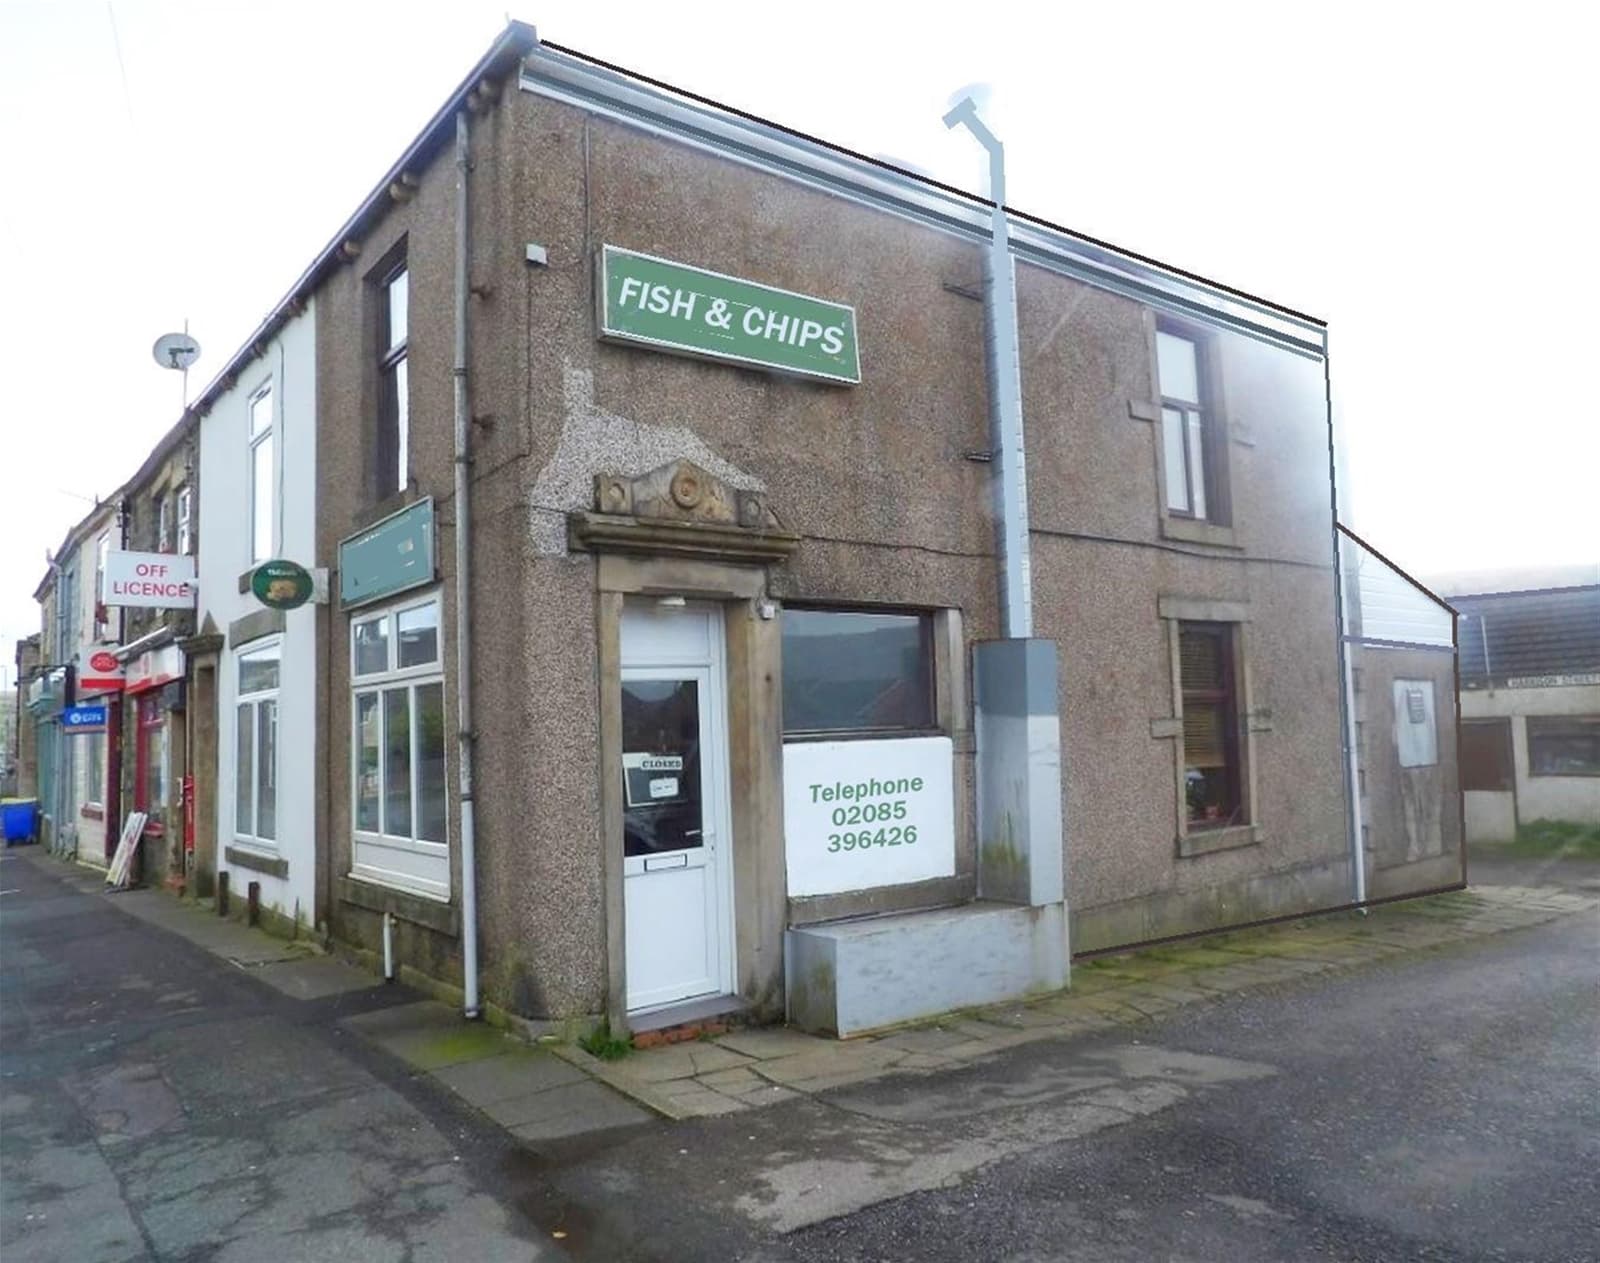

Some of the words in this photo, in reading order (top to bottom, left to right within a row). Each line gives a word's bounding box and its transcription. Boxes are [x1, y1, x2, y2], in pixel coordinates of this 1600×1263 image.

[618, 277, 697, 321] FISH
[704, 299, 733, 330] &
[742, 306, 845, 354] CHIPS
[136, 564, 168, 577] OFF
[113, 581, 189, 598] LICENCE
[809, 777, 923, 803] Telephone
[832, 801, 906, 826] 02085
[827, 825, 917, 853] 396426
